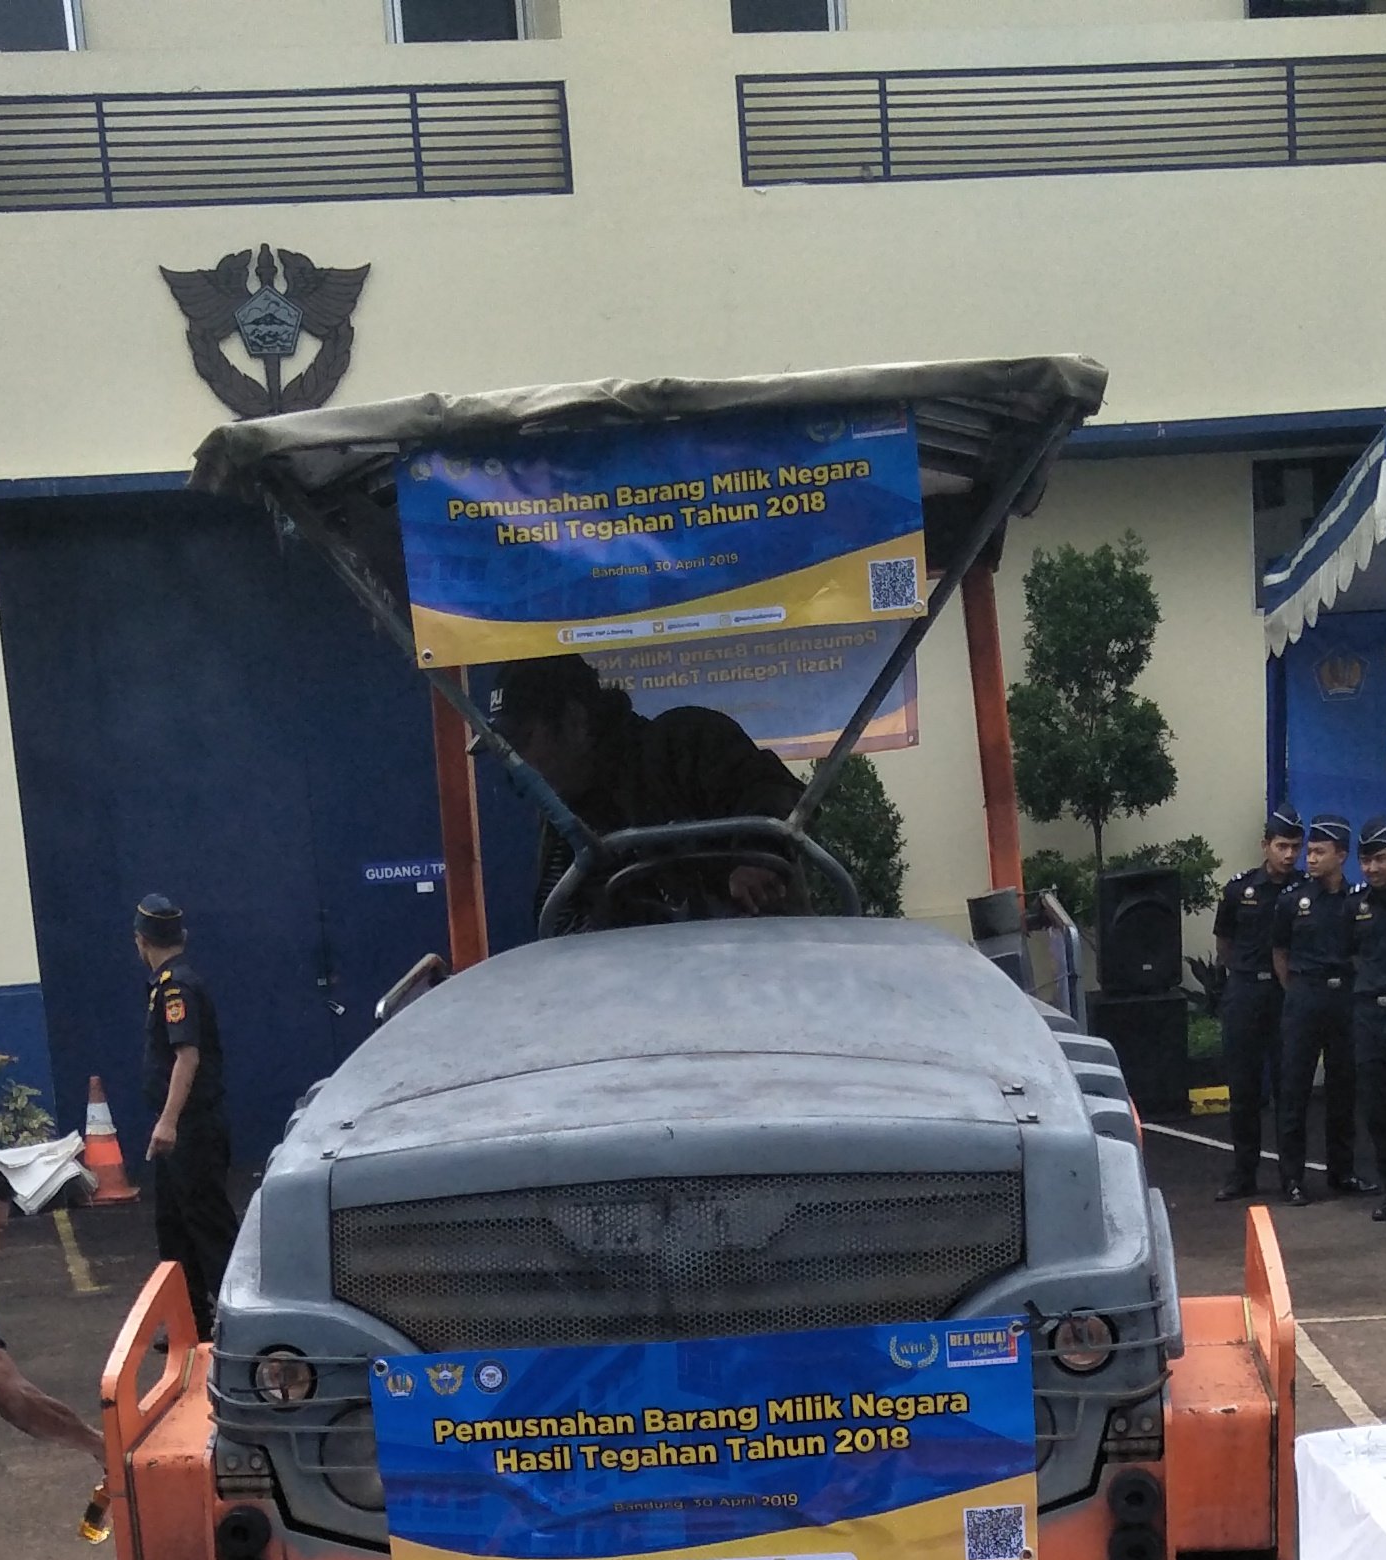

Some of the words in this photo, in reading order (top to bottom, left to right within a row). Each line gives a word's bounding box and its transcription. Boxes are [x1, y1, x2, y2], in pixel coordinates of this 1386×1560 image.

[448, 492, 610, 521] Pemusnahan
[615, 479, 705, 509] Barang
[712, 470, 773, 496] Milik
[778, 458, 872, 489] Negara
[497, 520, 559, 546] Hasil
[564, 510, 674, 543] Tegahan
[679, 501, 760, 528] Tahun
[765, 491, 827, 518] 2018
[654, 561, 672, 572] 30
[675, 557, 706, 571] April
[709, 552, 739, 567] 2019
[365, 865, 422, 880] GUDANG
[949, 1332, 971, 1347] BEA
[973, 1330, 1007, 1345] CUKAI
[432, 1411, 636, 1446] Pemusnahan
[644, 1403, 758, 1437] Barang
[766, 1394, 841, 1425] Milik
[850, 1388, 970, 1424] Negara
[495, 1445, 573, 1475] Hasil
[580, 1438, 718, 1474] Tegahan
[725, 1432, 825, 1463] Tahun
[834, 1426, 911, 1455] 2018
[719, 1495, 756, 1508] April
[761, 1492, 799, 1508] 2019
